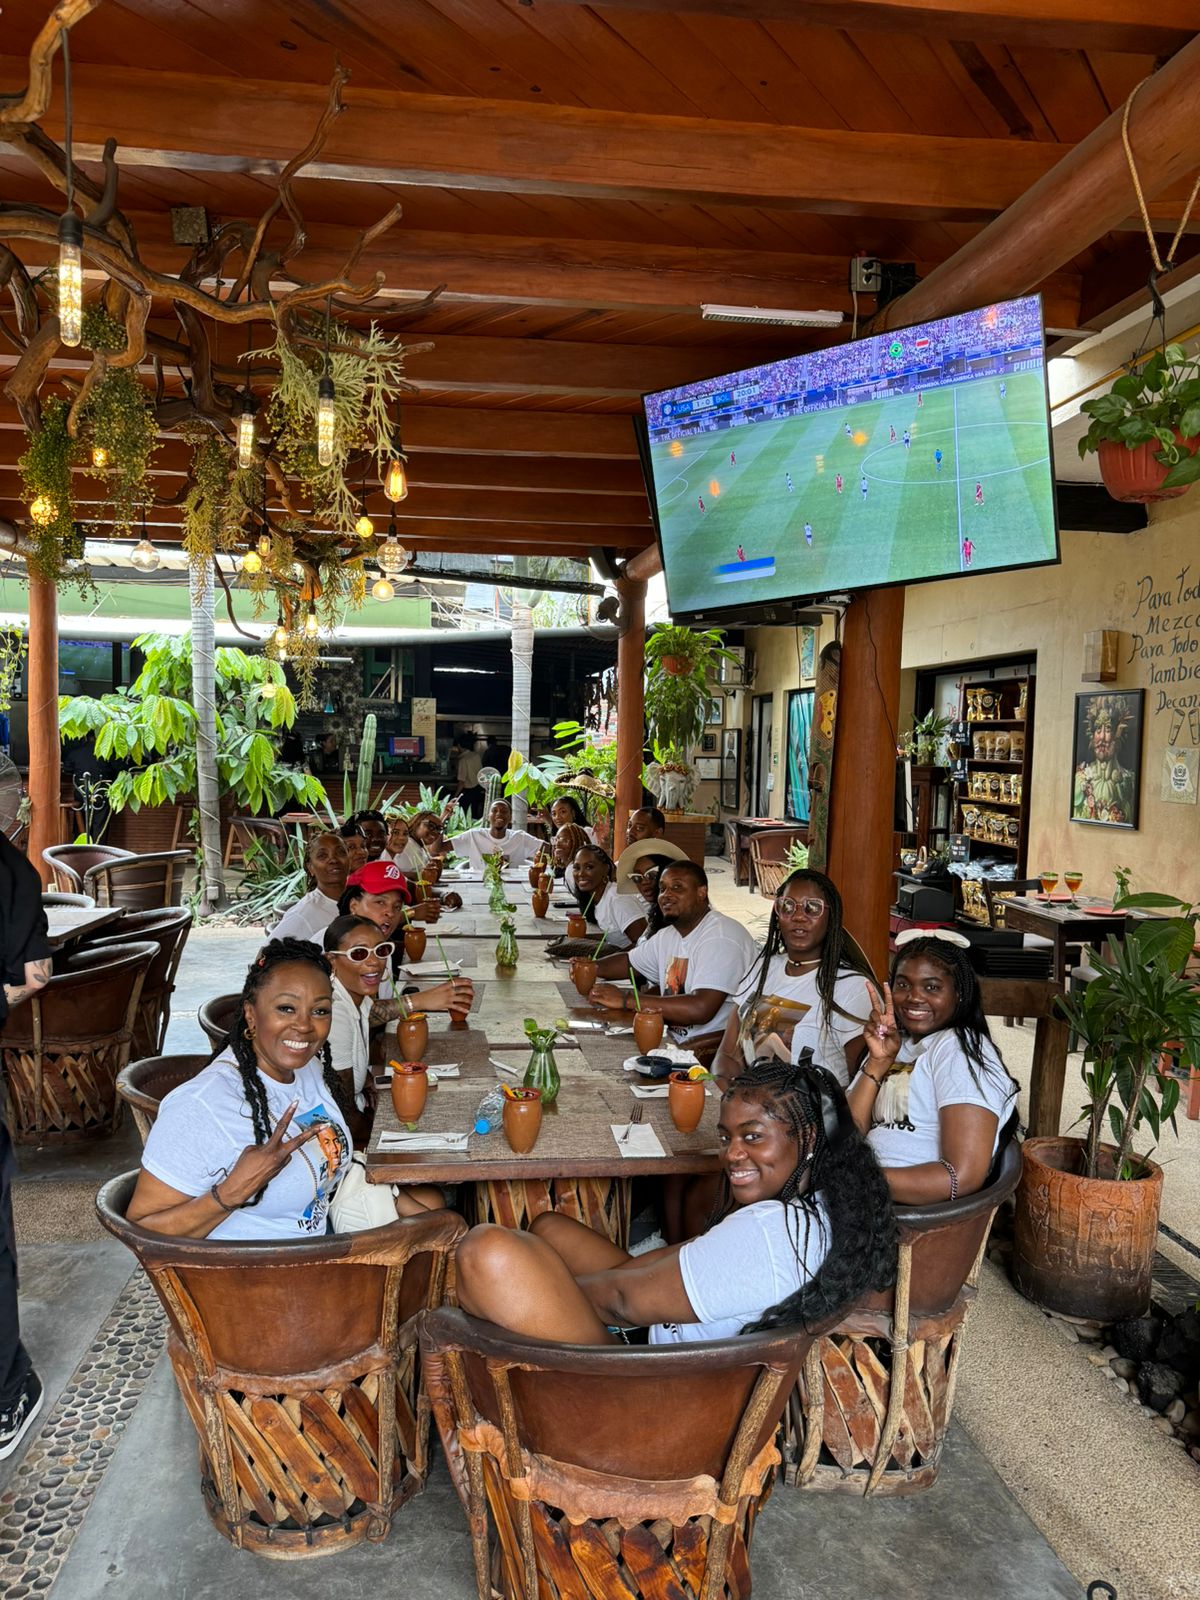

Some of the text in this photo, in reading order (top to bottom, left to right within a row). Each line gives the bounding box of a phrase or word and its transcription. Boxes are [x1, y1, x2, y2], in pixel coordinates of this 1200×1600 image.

[871, 388, 895, 400] PUMA
[679, 403, 691, 413] USA
[793, 405, 804, 415] THE
[804, 400, 828, 413] OFFICIAL
[829, 397, 843, 409] BALL
[1132, 575, 1172, 618] Para
[1127, 633, 1164, 664] Para
